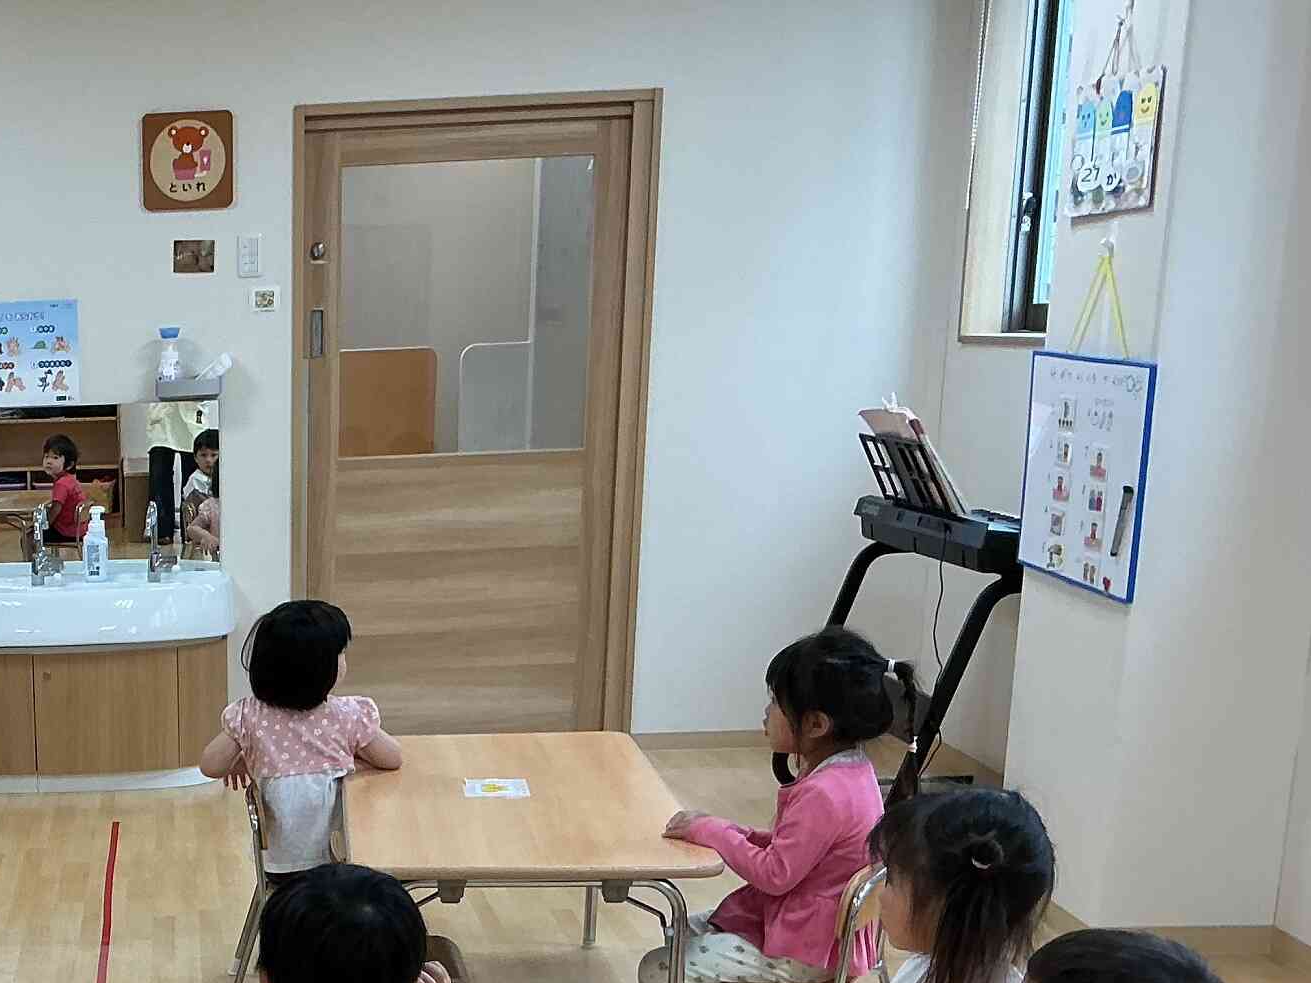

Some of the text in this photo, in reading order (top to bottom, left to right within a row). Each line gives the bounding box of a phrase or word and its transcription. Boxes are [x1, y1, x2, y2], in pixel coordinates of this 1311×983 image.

[1081, 167, 1100, 183] 27
[169, 182, 206, 193] といれ
